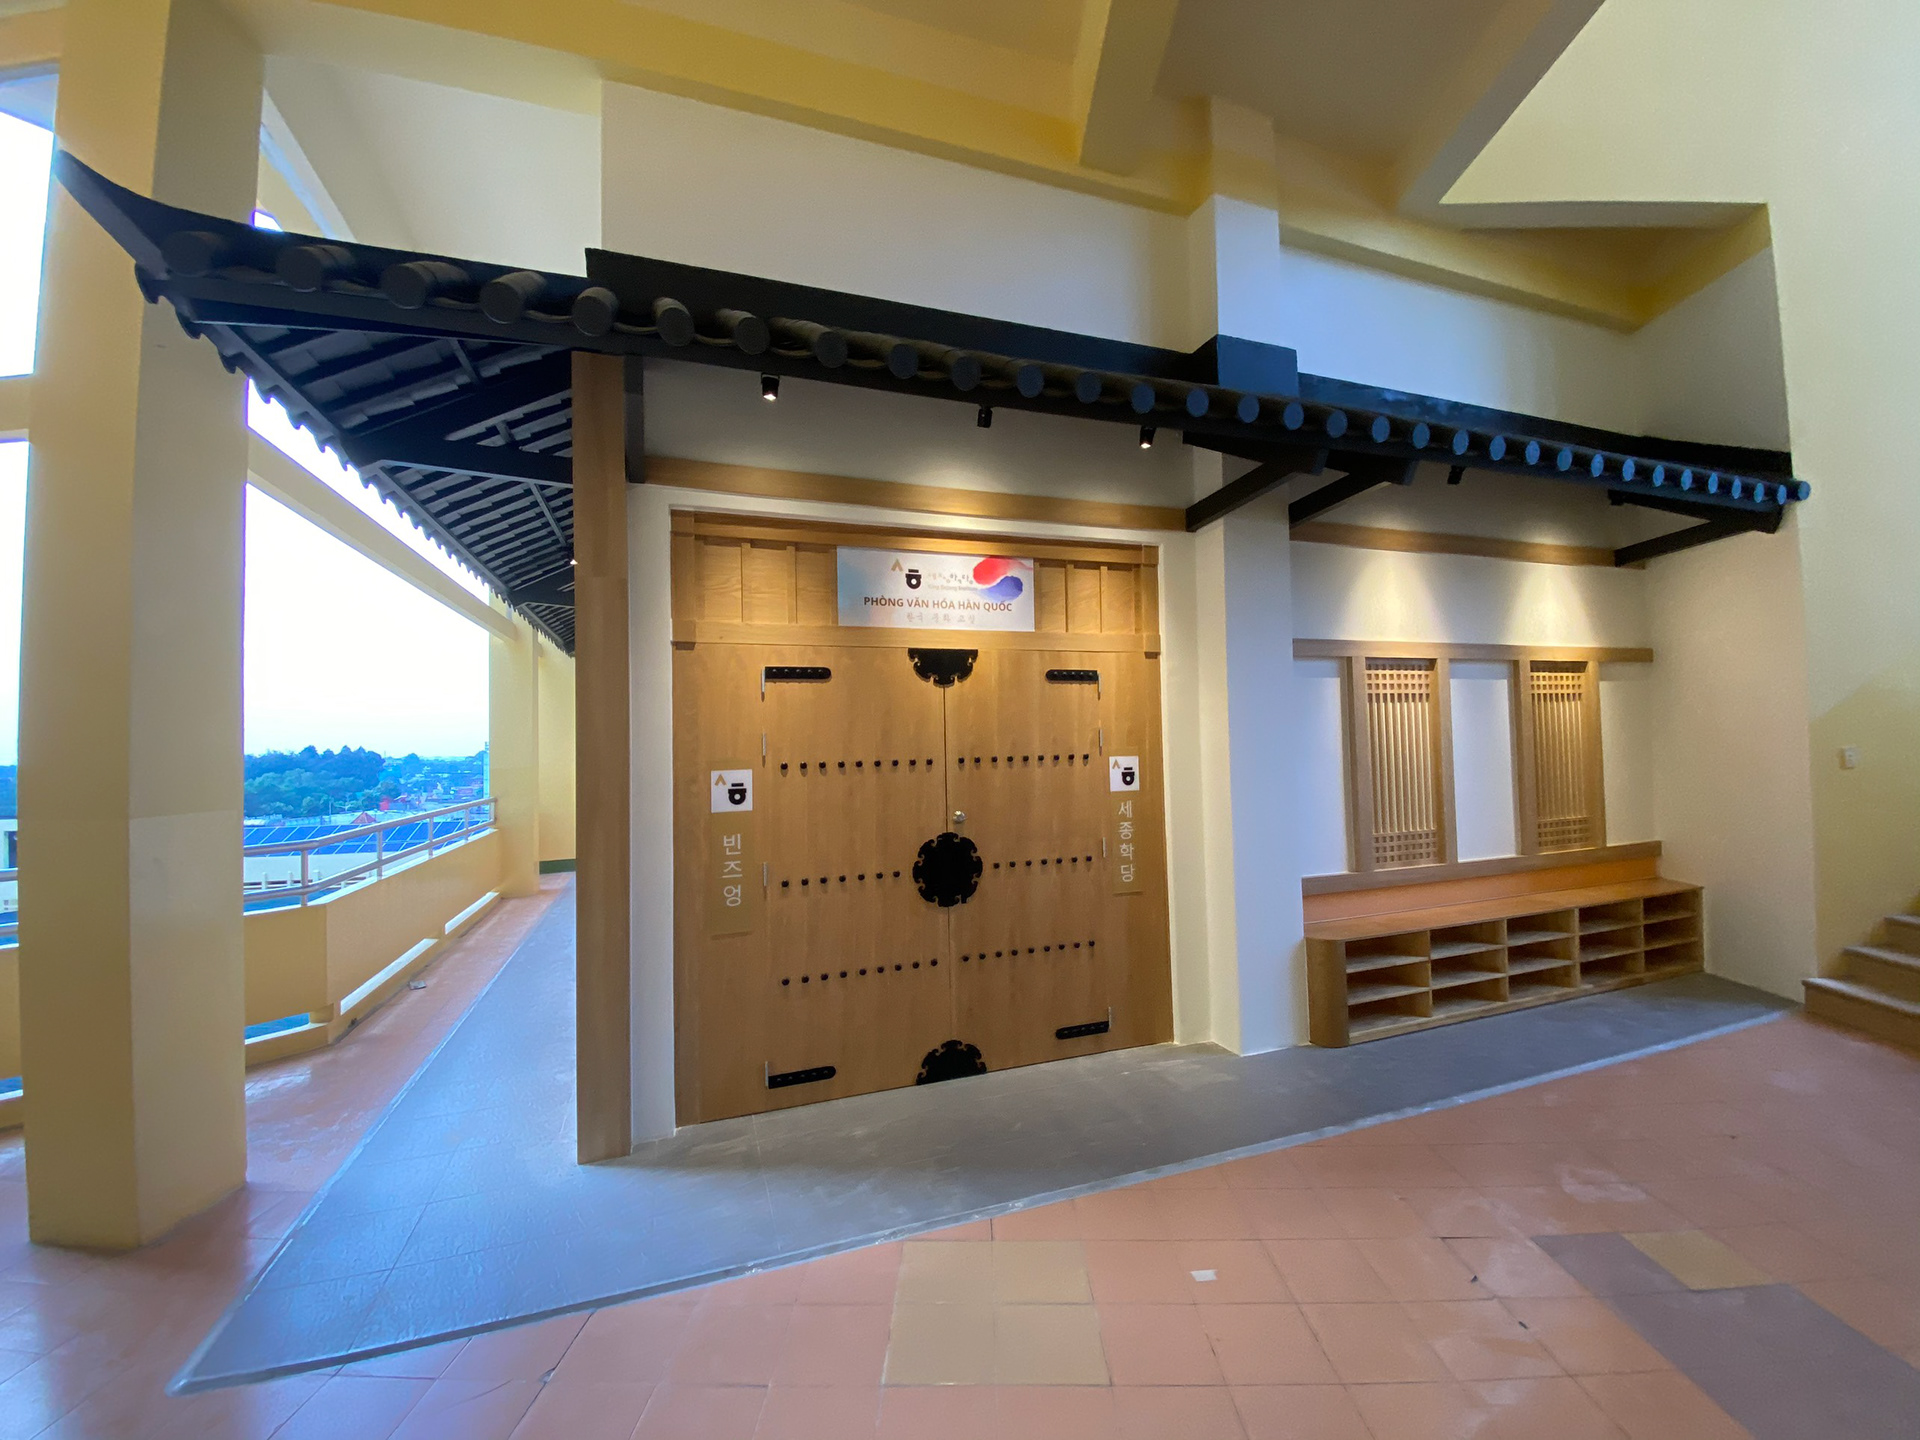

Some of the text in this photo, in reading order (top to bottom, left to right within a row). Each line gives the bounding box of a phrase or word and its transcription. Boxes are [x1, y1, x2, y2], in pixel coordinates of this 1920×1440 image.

[863, 595, 1012, 612] PHÒNG VĂN HÓA HÀN QUỐC
[722, 833, 743, 907] 빈즈엉
[1118, 800, 1135, 882] 세종학당
